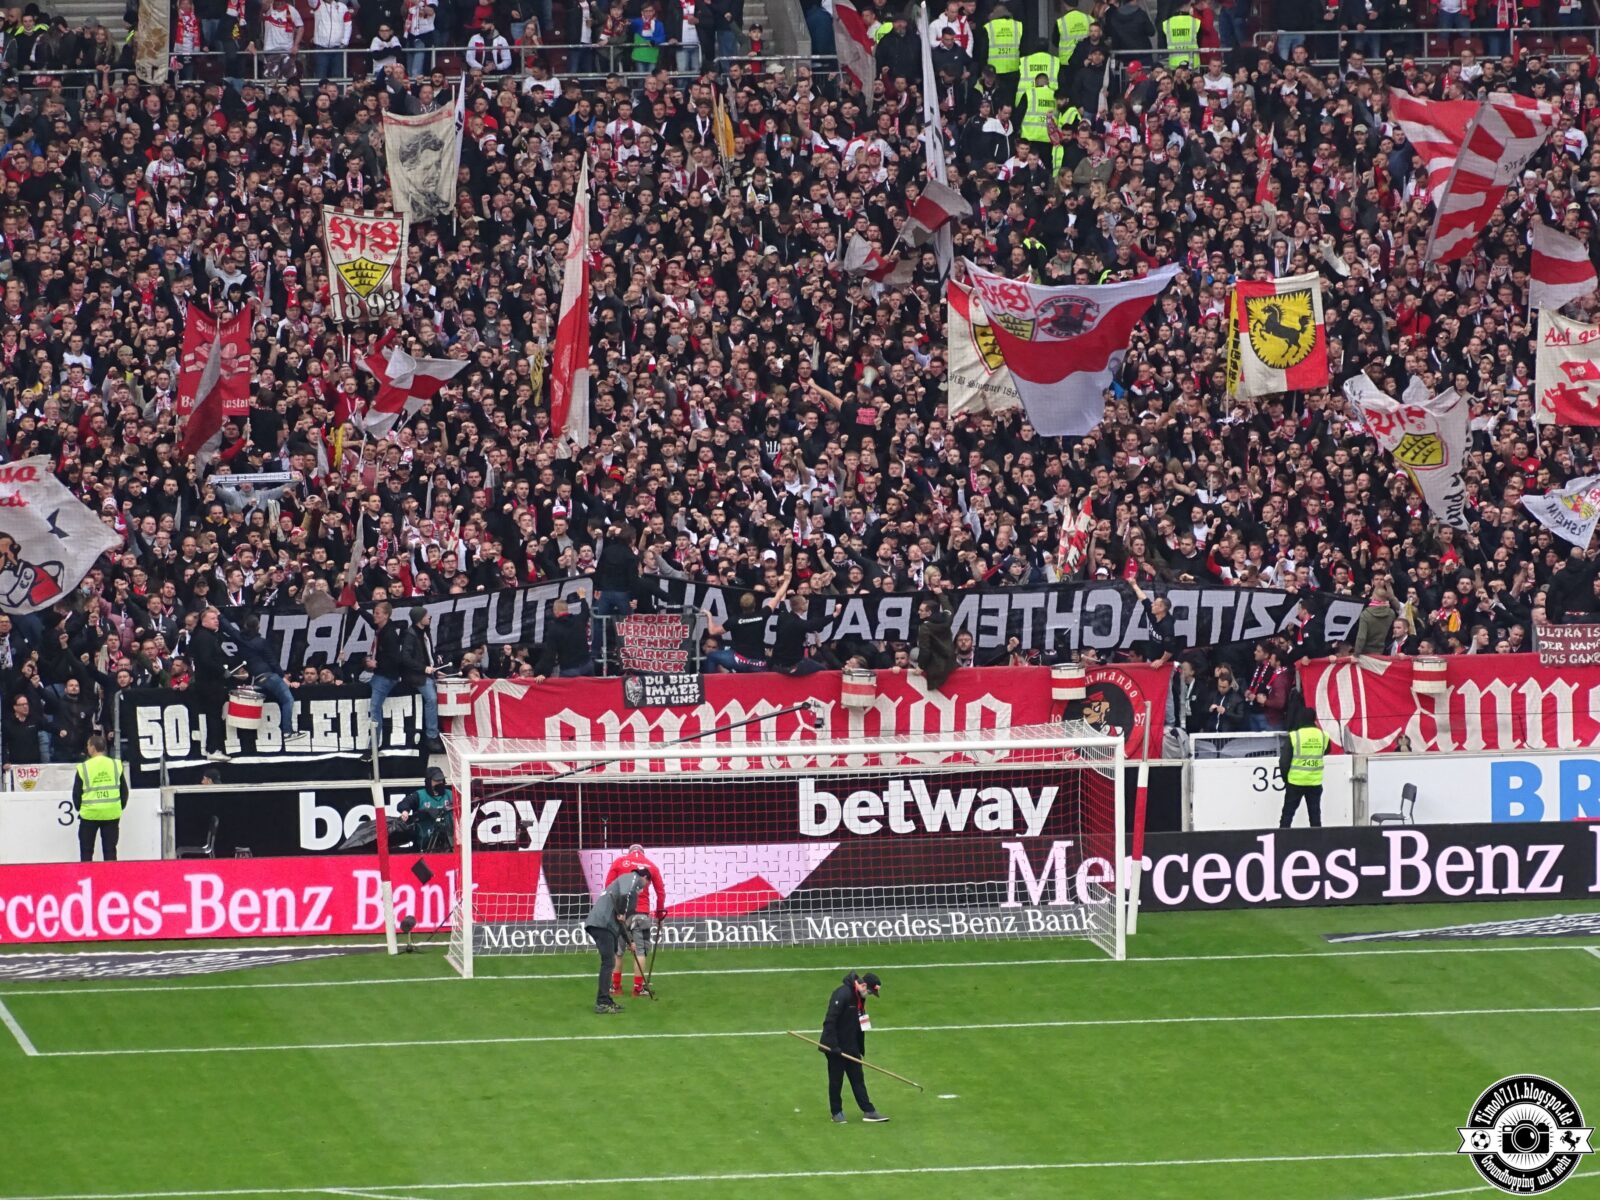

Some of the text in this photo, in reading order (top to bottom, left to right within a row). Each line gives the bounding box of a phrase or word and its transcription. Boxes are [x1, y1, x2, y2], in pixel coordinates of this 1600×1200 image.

[1172, 28, 1190, 37] SECURITY
[1029, 64, 1048, 72] SECURITY
[332, 289, 401, 322] 1893
[1003, 386, 1021, 400] 189
[615, 622, 690, 638] VERBANNTE
[1536, 626, 1582, 637] ULTRA
[1538, 640, 1564, 650] DER
[1540, 653, 1567, 664] UMS
[644, 674, 699, 685] DU BIST
[645, 684, 700, 696] IMMER
[646, 694, 700, 705] BEI UNS!
[1252, 766, 1286, 792] 35
[58, 801, 81, 826] 3
[799, 777, 1059, 837] betway
[1000, 830, 1566, 908] Mercedes-Benz
[0, 874, 332, 939] cedes-Benz
[705, 917, 780, 943] Bank
[804, 907, 1101, 940] Mercedes-Benz Bank
